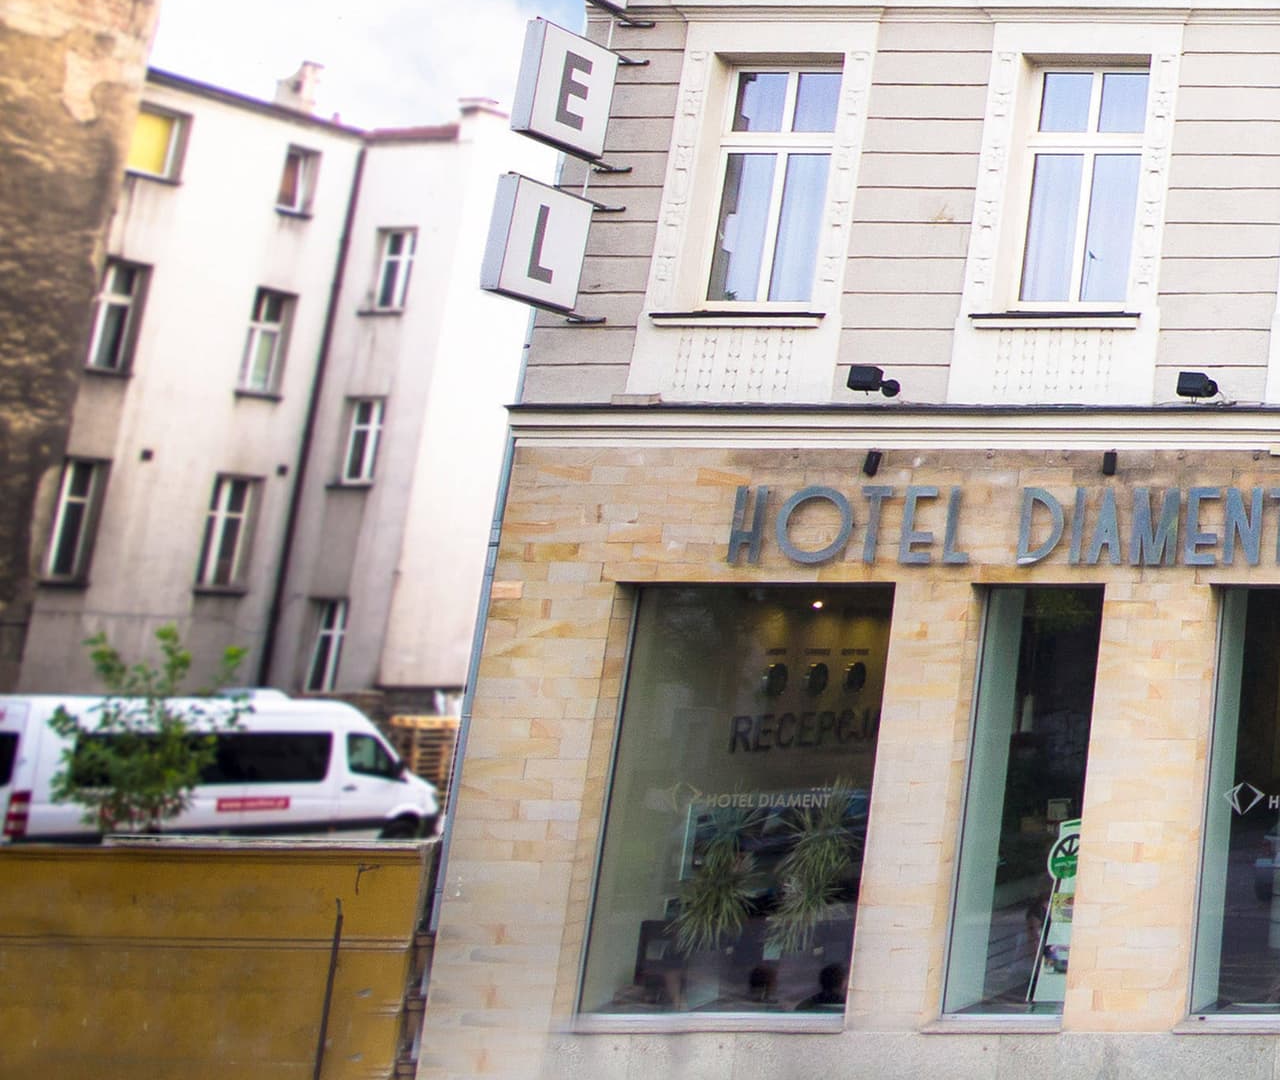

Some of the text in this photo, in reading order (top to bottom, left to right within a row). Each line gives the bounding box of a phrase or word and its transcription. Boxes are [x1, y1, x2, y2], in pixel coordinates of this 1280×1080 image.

[727, 485, 969, 566] HOTEL
[706, 793, 833, 809] HOTEL DIAMENT
